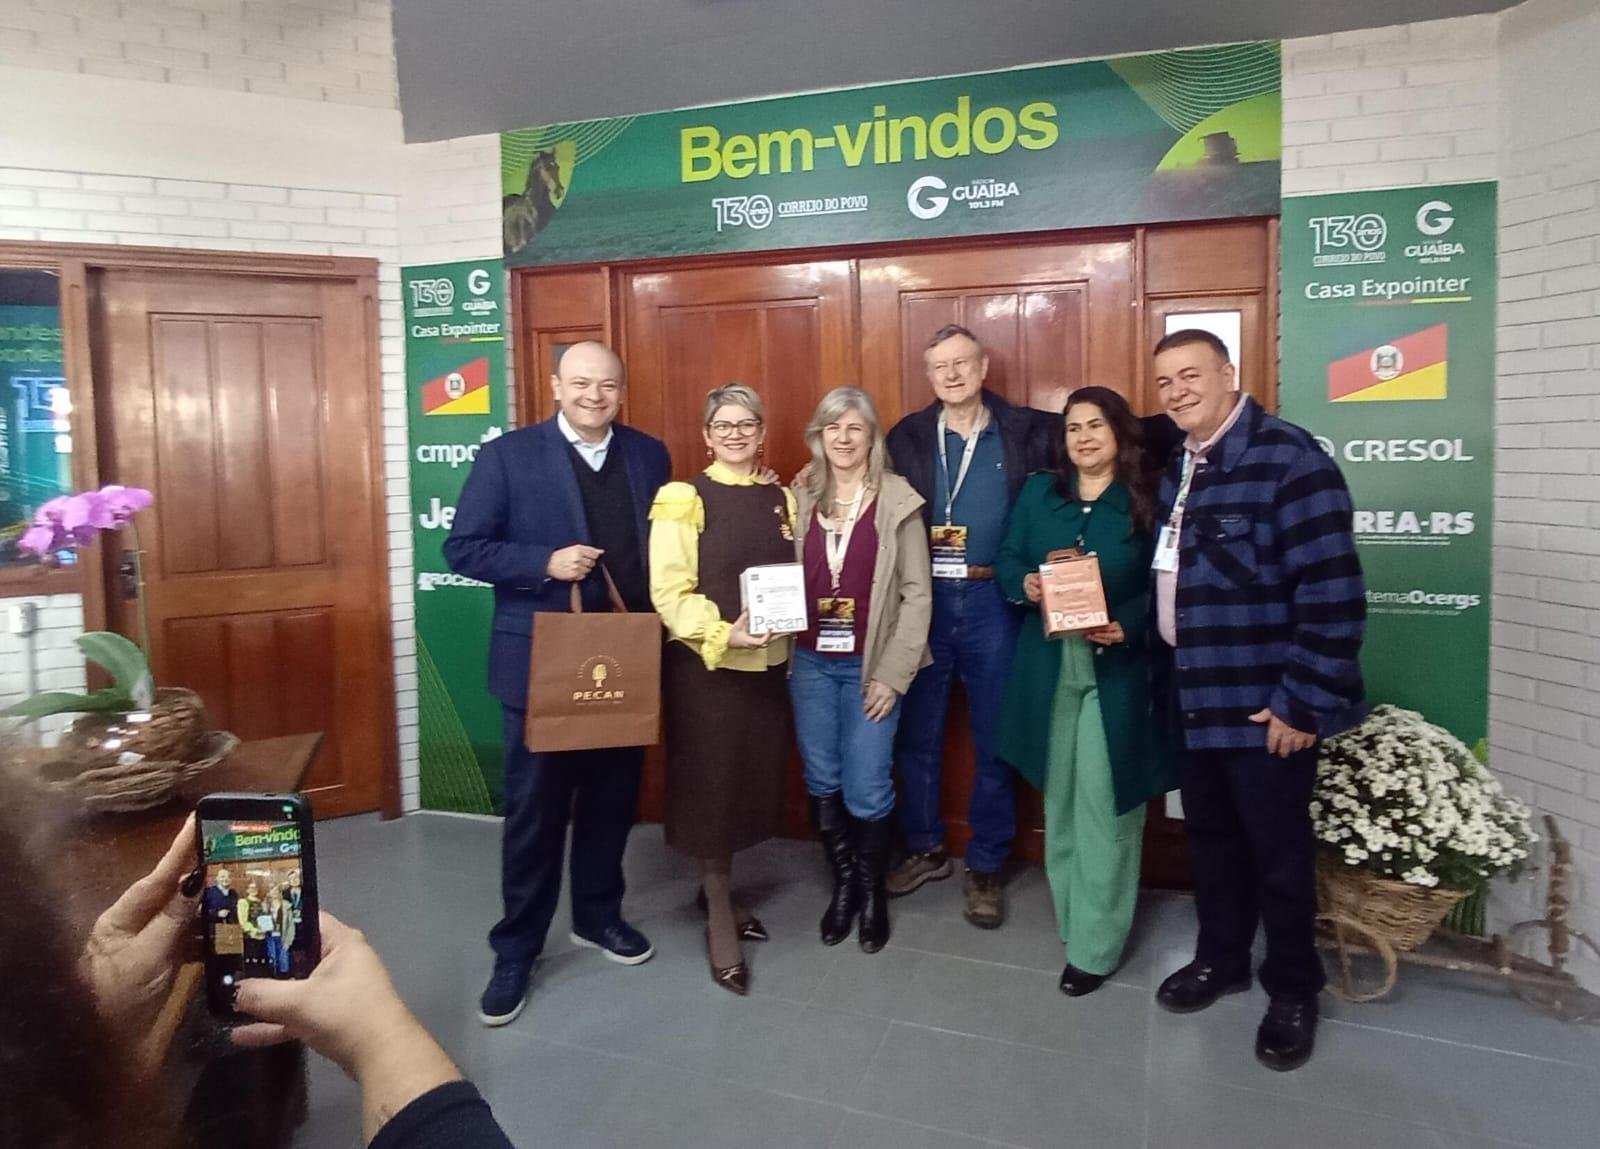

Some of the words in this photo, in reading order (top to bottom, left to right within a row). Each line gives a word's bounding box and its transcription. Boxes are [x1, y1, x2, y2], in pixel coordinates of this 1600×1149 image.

[680, 95, 1060, 183] Bem-vindos
[778, 199, 823, 215] CORREIO
[825, 197, 839, 210] DO
[841, 195, 868, 209] POVO
[907, 175, 950, 220] G
[991, 199, 1004, 207] FM
[711, 194, 774, 232] 130
[1416, 200, 1455, 236] G
[1308, 213, 1388, 254] 130
[467, 269, 492, 295] G
[1304, 281, 1356, 300] Casa
[1361, 275, 1471, 300] Expointer
[411, 325, 440, 338] Casa
[441, 321, 501, 339] Expointer
[1343, 438, 1475, 462] CRESOL
[1352, 510, 1475, 534] REA-RS
[1364, 590, 1481, 609] temaOcergs
[752, 615, 807, 632] Pecan
[572, 690, 625, 701] PECAN
